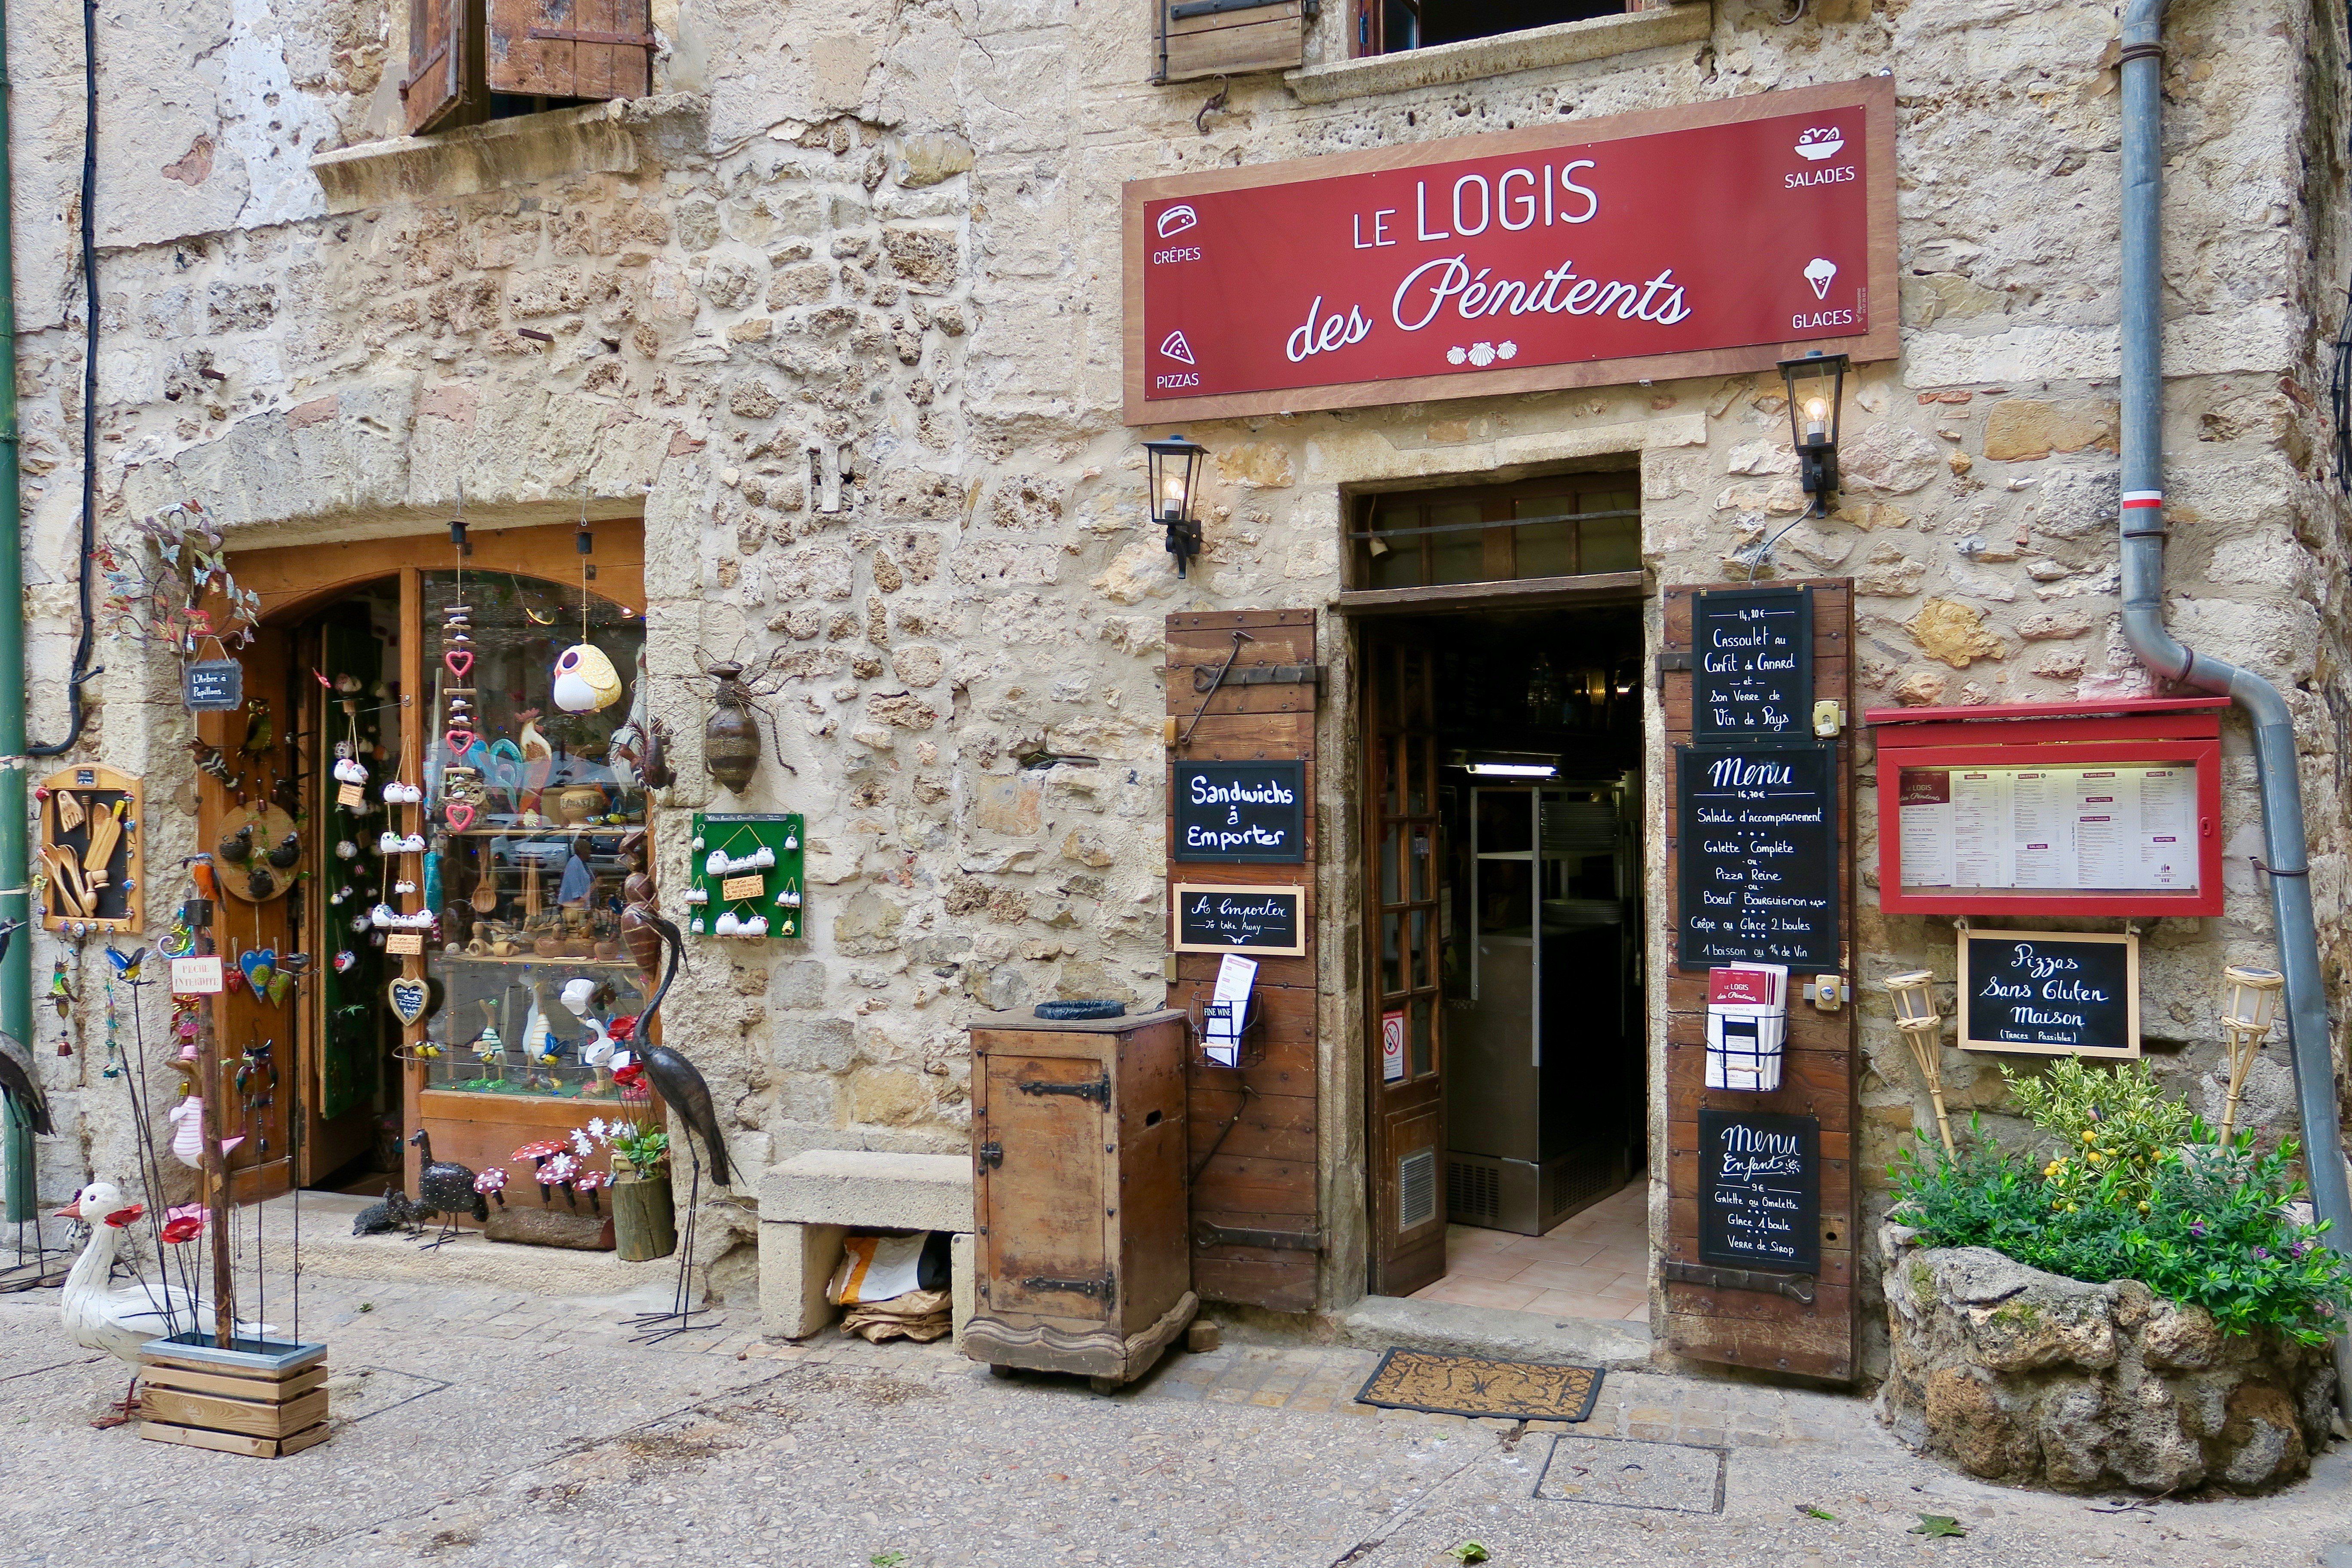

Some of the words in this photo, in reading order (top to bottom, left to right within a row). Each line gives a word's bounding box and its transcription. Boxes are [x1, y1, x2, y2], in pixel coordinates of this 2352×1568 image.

[1784, 164, 1855, 190] SALADES
[1354, 208, 1396, 250] LE
[1417, 159, 1599, 242] LOGIS
[1152, 245, 1201, 265] CRÊPES
[1286, 296, 1373, 363] des
[1392, 253, 1690, 332] Pénitents
[1792, 306, 1852, 330] GLACES
[1156, 371, 1200, 389] PIZZAS
[1704, 652, 1737, 673] Confit
[1745, 660, 1753, 671] de
[193, 673, 218, 684] L'Arbre
[1709, 690, 1727, 702] Son
[1769, 689, 1780, 701] de
[1713, 708, 1735, 726] Vin
[1744, 712, 1755, 726] de
[1762, 706, 1789, 732] Pays
[1708, 757, 1792, 787] Menu
[1191, 775, 1293, 805] Sandwichs
[1227, 805, 1239, 825] à
[1697, 808, 1734, 823] Salade
[1187, 824, 1284, 851] Emporter
[1704, 841, 1740, 853] Galette
[1750, 841, 1794, 857] Complète
[1752, 869, 1781, 881] Reine
[1704, 891, 1736, 904] Boeuf
[1191, 896, 1210, 914] A
[1217, 898, 1286, 922] Emporter
[1205, 920, 1215, 929] To
[1221, 920, 1237, 930] take
[1241, 921, 1261, 934] Away
[1690, 916, 1715, 932] Crêpe
[1723, 922, 1733, 931] ou
[1740, 917, 1766, 931] Glace
[1771, 919, 1779, 930] 2
[1782, 917, 1810, 931] boules
[1703, 944, 1709, 954] 1
[1712, 944, 1746, 956] boisson
[1754, 948, 1764, 958] ou
[1782, 945, 1790, 957] de
[1794, 946, 1807, 957] Vin
[2011, 943, 2078, 978] Pizzas
[175, 978, 218, 987] INTERDITE
[1979, 976, 2031, 997] Sans
[2042, 980, 2109, 1001] Gluten
[1204, 1008, 1216, 1016] FINE
[1217, 1008, 1231, 1016] WINE
[2010, 1006, 2085, 1026] Maison
[2038, 1031, 2076, 1043] Possibles)
[1721, 1124, 1801, 1156] Menu
[1723, 1152, 1788, 1182] Enfant
[1752, 1184, 1764, 1192] 9€
[1715, 1191, 1743, 1205] Galette
[1762, 1197, 1798, 1209] Omelette
[1727, 1213, 1752, 1227] Glace
[1758, 1218, 1765, 1228] 1
[1768, 1219, 1791, 1231] boule
[1757, 1239, 1766, 1251] de
